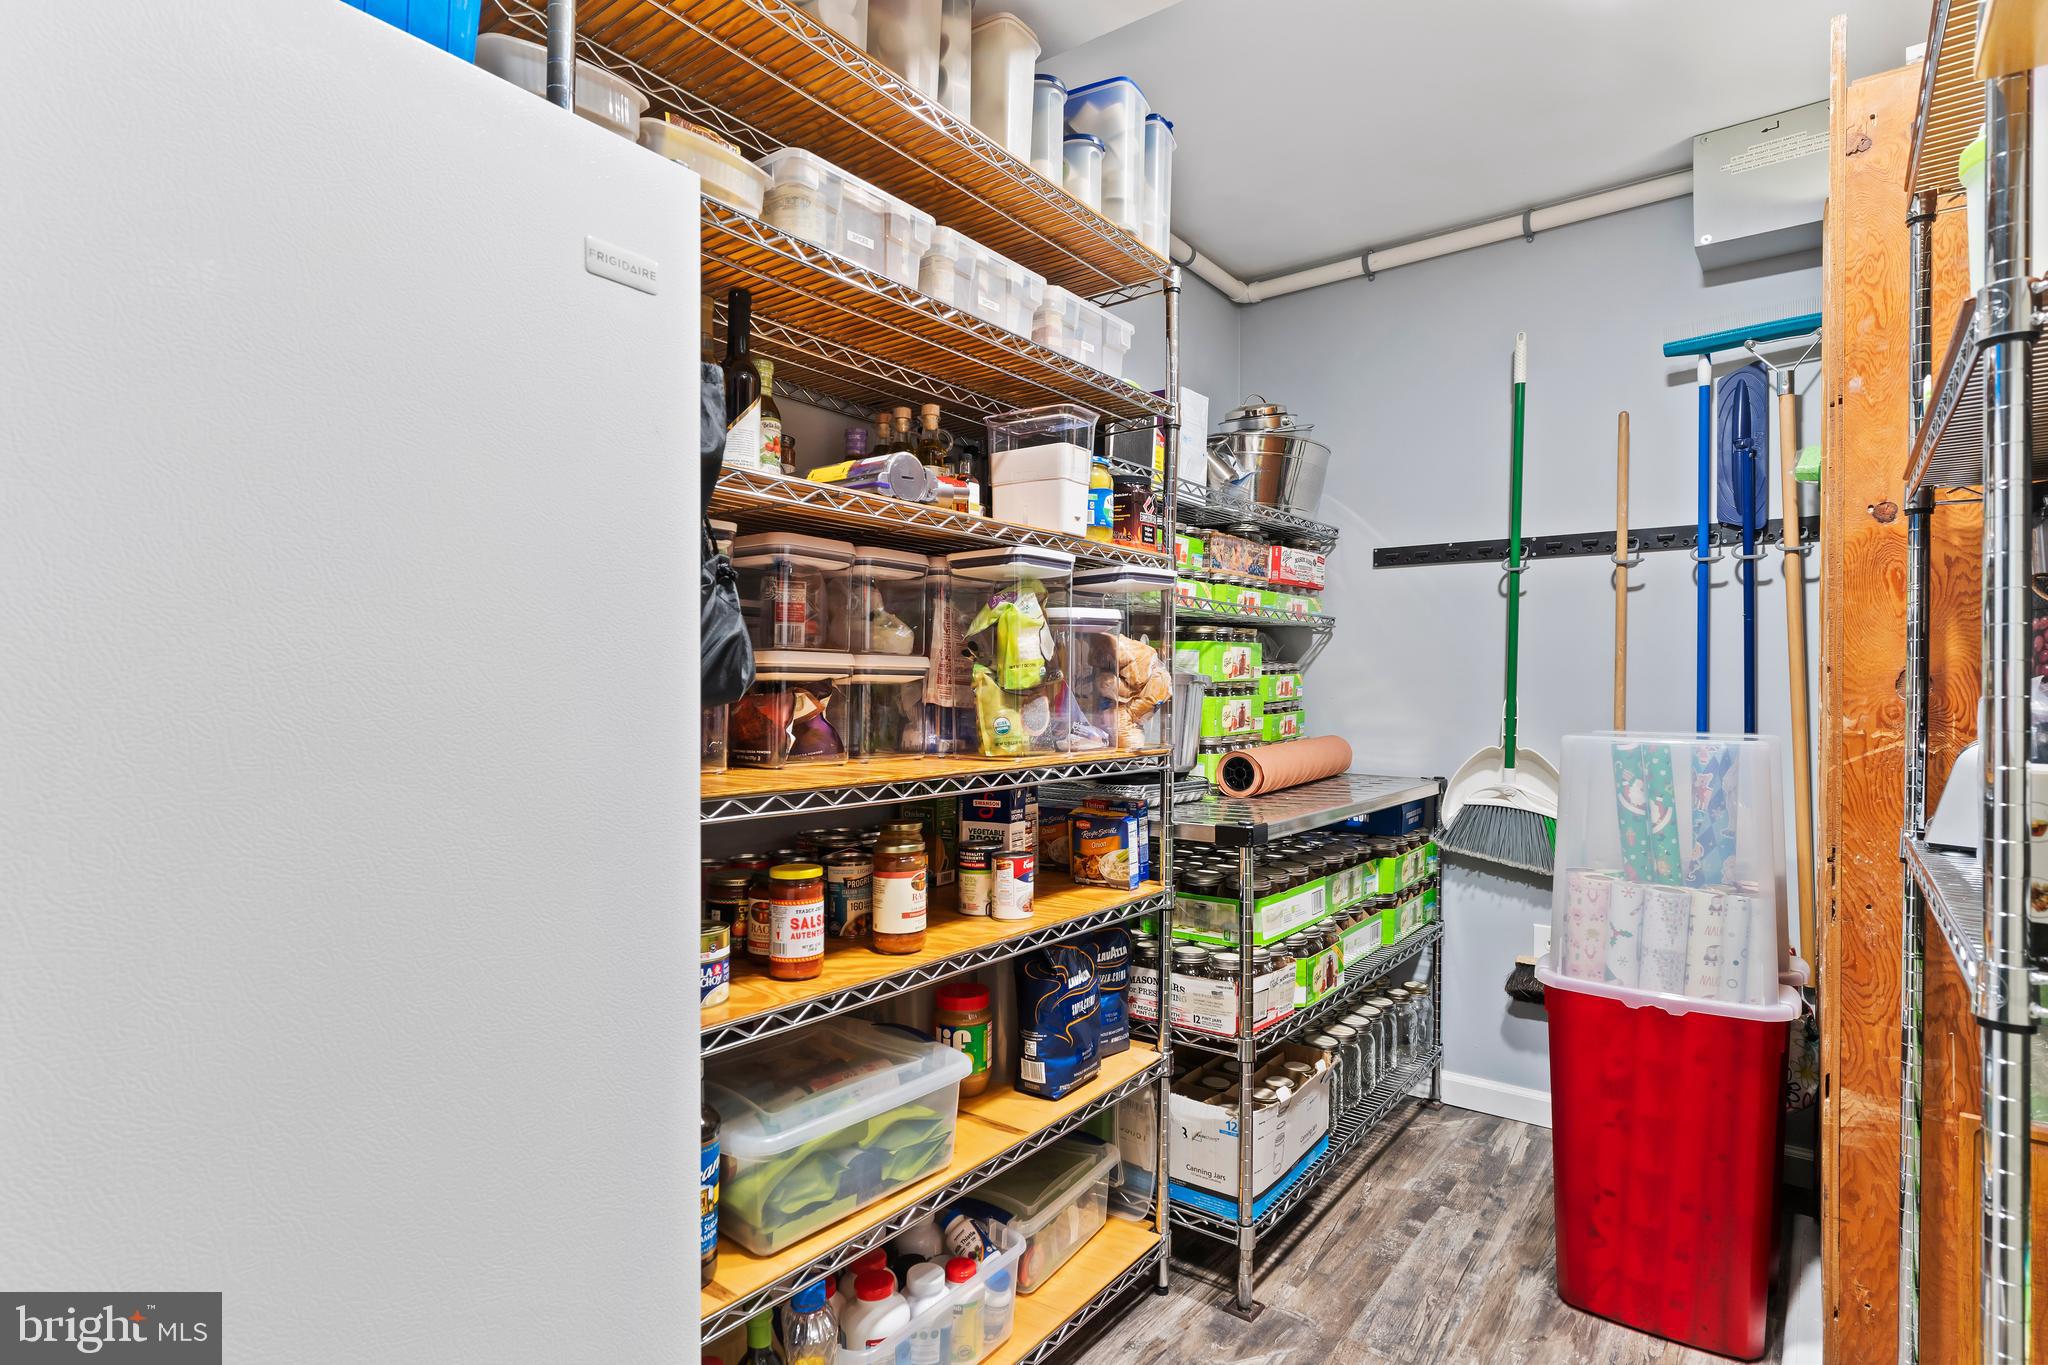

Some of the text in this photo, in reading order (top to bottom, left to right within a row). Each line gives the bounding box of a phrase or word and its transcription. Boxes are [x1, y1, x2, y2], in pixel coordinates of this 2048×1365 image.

[588, 247, 657, 281] FRIGIDAIRE
[968, 827, 1006, 837] VEGETABLE
[850, 901, 864, 911] 160
[1193, 1014, 1201, 1025] 12
[1225, 1121, 1237, 1132] 12
[1186, 1163, 1226, 1181] Canning Jars
[960, 1231, 976, 1245] Thistle
